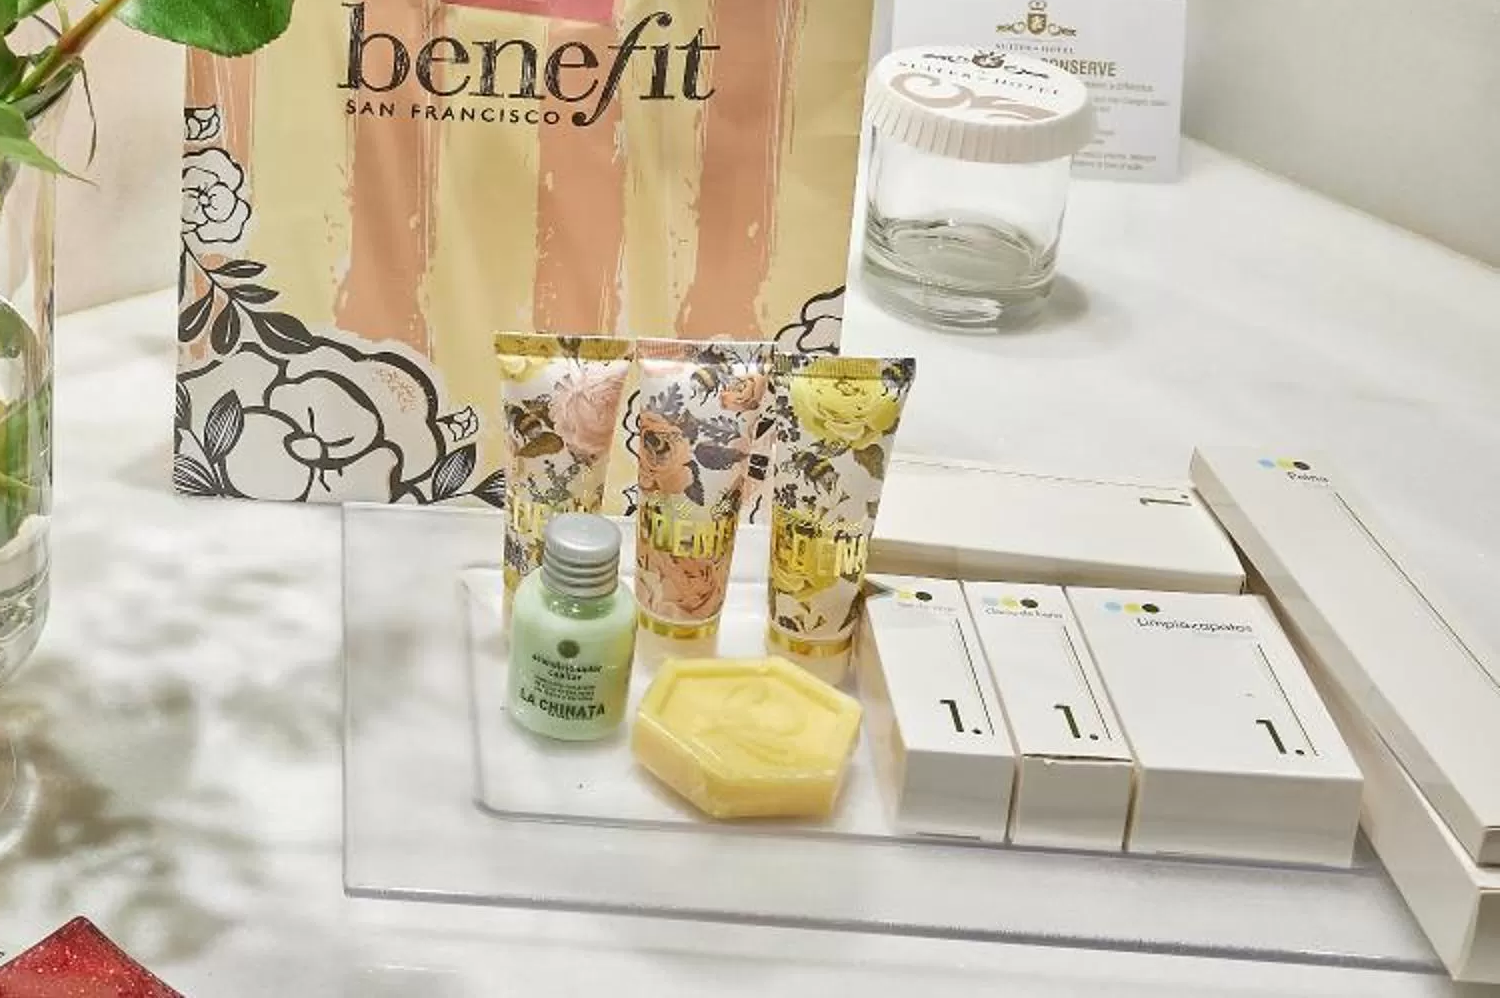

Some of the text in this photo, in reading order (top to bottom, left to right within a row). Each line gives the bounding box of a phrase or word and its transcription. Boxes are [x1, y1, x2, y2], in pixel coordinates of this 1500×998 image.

[337, 1, 721, 127] benefit
[346, 100, 560, 124] SAN FRANCISCO
[520, 687, 535, 705] LA
[539, 699, 605, 718] CHINATA
